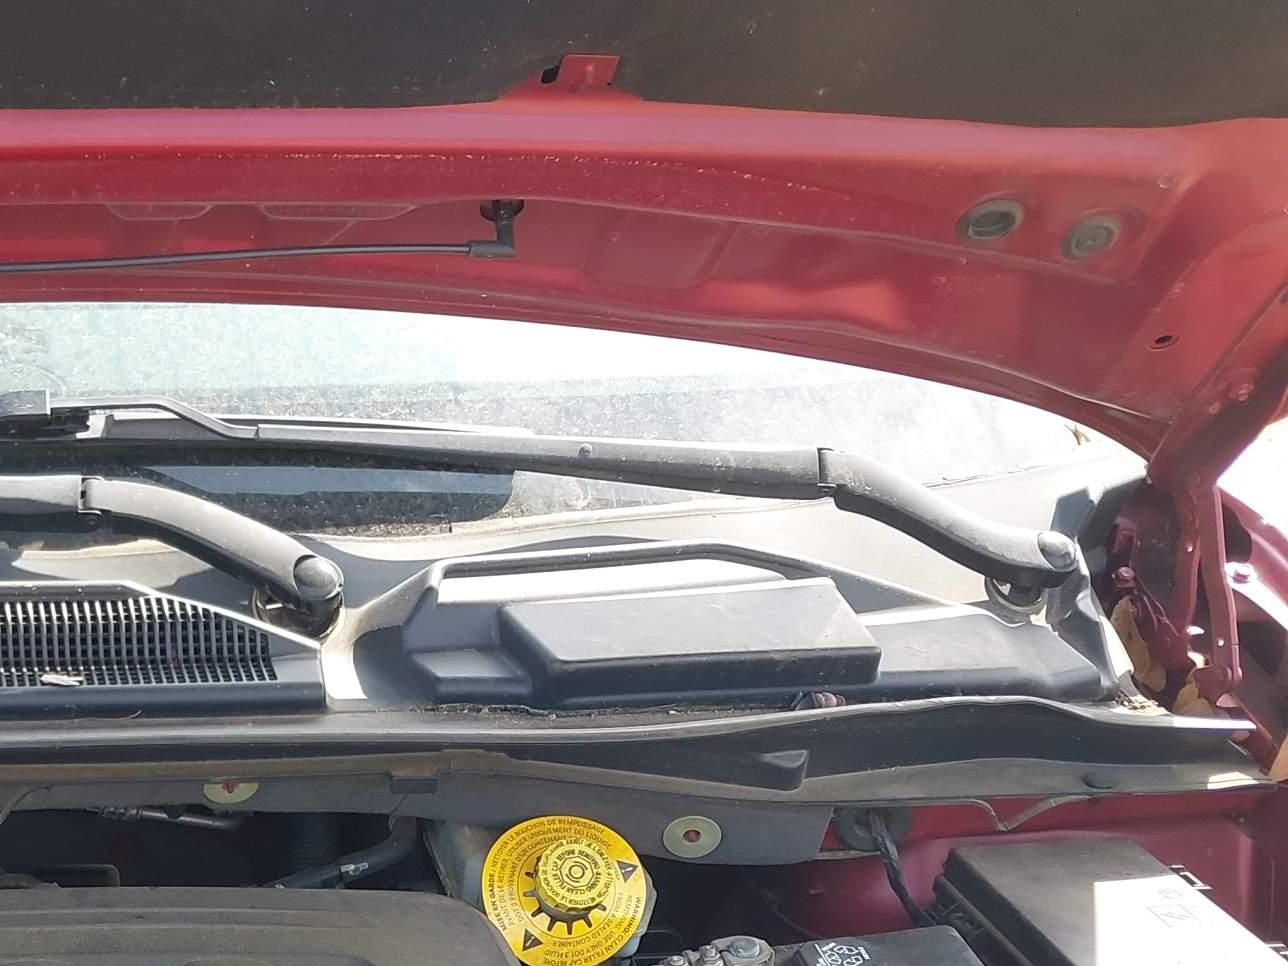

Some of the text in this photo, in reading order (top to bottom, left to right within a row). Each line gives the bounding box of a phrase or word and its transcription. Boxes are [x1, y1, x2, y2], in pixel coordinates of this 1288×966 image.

[514, 821, 546, 836] BOUCHON
[488, 873, 496, 898] GARDE
[491, 900, 499, 911] EN
[494, 912, 507, 931] MISE
[592, 918, 614, 938] SEALED
[603, 931, 616, 941] USE
[605, 935, 624, 951] CLEAN
[586, 941, 603, 951] ONLY
[569, 959, 582, 966] CAP
